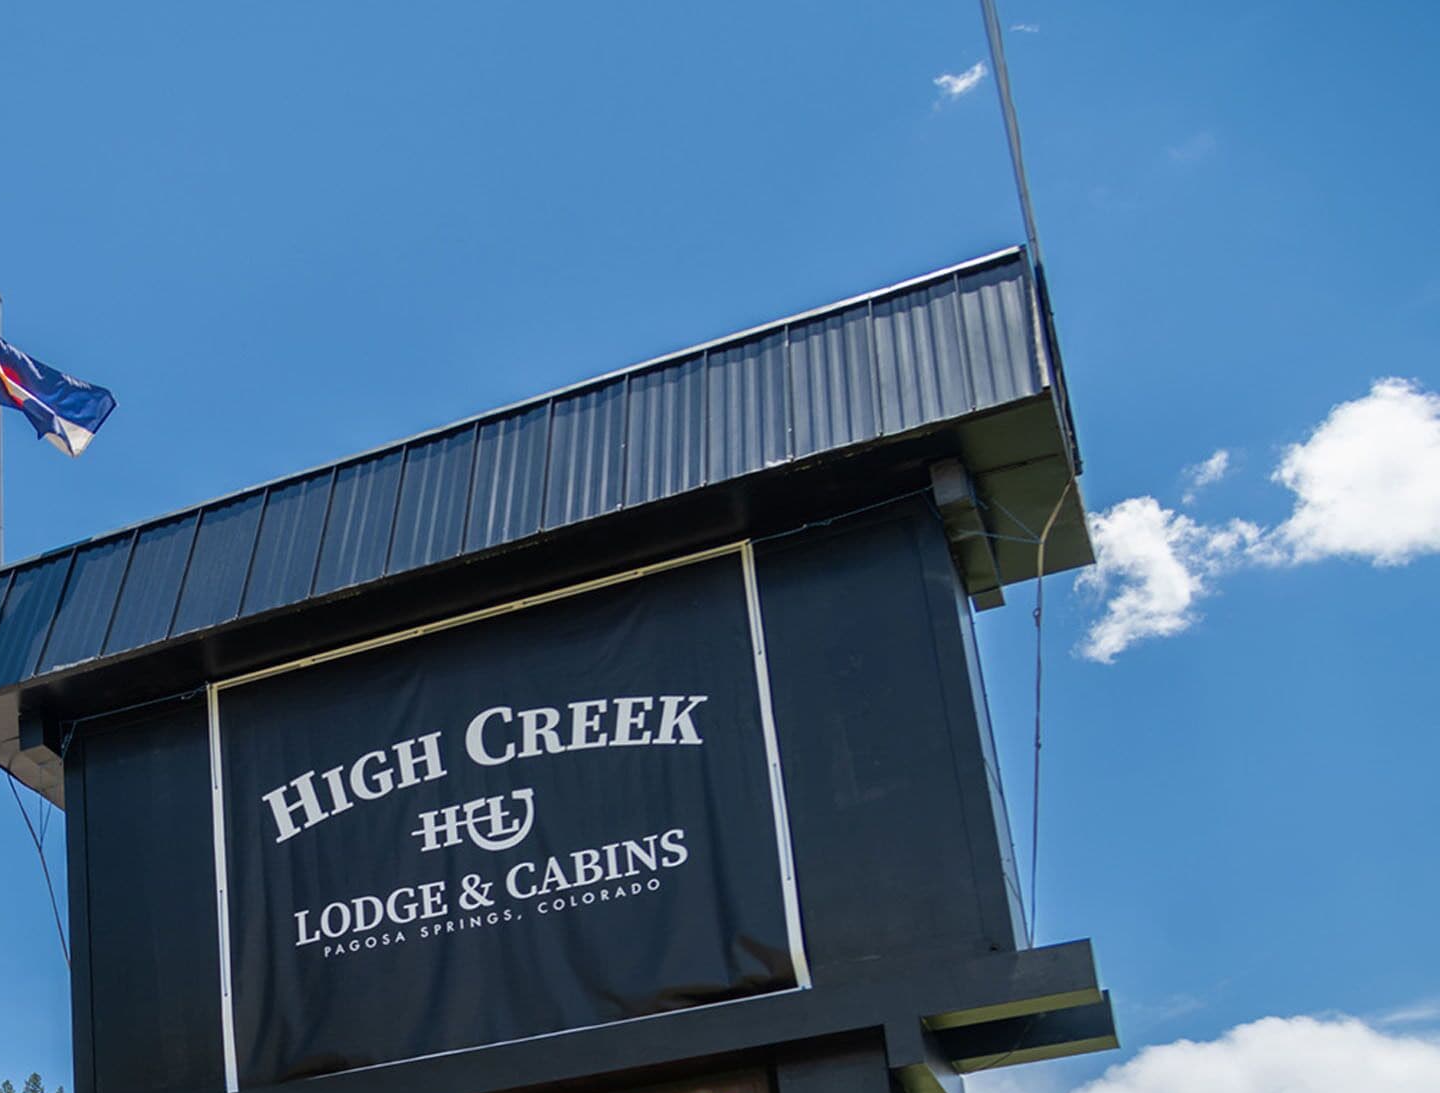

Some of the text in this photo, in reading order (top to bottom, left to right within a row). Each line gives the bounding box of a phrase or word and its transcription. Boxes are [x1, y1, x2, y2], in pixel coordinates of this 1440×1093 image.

[262, 695, 708, 844] HIGH CREEK
[294, 828, 689, 946] LODGE & CABINS
[324, 878, 661, 958] PAGOSA SPRINGS, COLORADO
